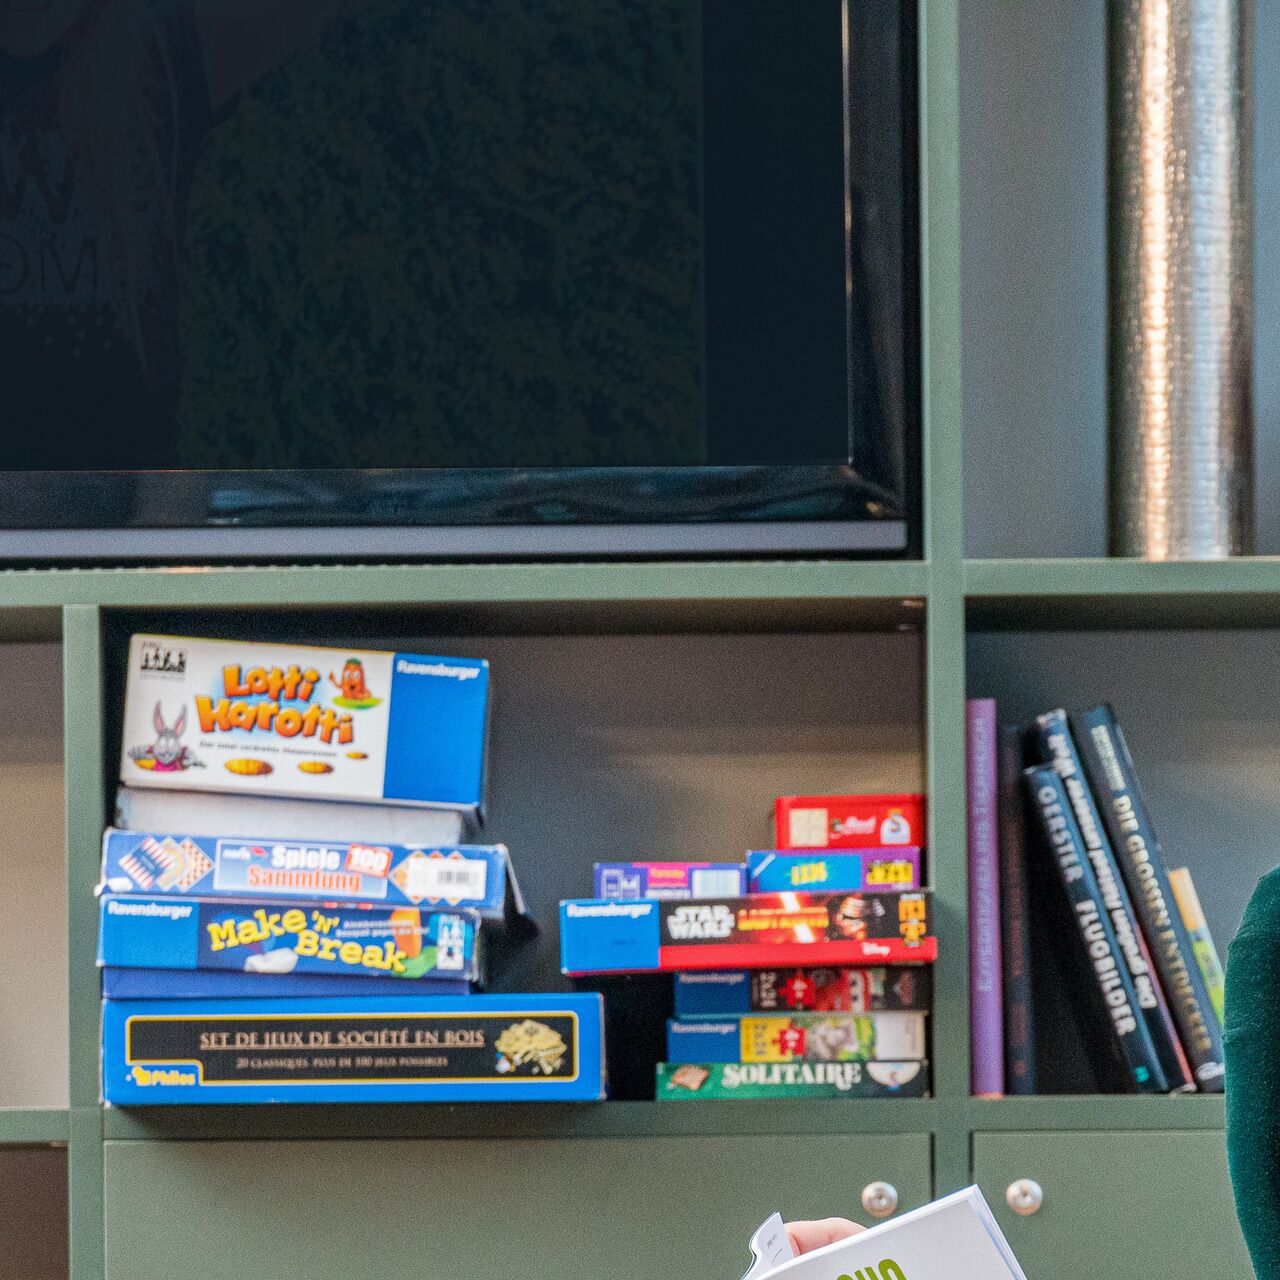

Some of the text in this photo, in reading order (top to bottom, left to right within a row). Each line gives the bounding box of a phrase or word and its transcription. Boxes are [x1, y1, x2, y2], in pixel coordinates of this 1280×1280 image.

[223, 663, 319, 701] Lotti
[397, 659, 480, 681] Ravensburger
[195, 695, 353, 744] Karotti
[1047, 733, 1076, 778] Welt
[1113, 794, 1140, 831] DIE
[271, 845, 340, 871] Spiele
[350, 846, 389, 871] 100
[248, 866, 361, 893] Sammlung
[1126, 834, 1171, 928] GROSSEN
[108, 901, 193, 921] Ravensburger
[566, 902, 652, 919] Ravensburger
[672, 905, 732, 922] STAR
[207, 909, 307, 951] Make
[670, 920, 734, 939] WARS
[294, 930, 407, 973] Break
[1076, 899, 1137, 1037] FLUGBILDER
[1134, 974, 1158, 1010] Die
[200, 1028, 485, 1048] SET DE JEUX DE SOCIÉTÉ EN BOIS
[721, 1062, 863, 1091] SOLITAIRE
